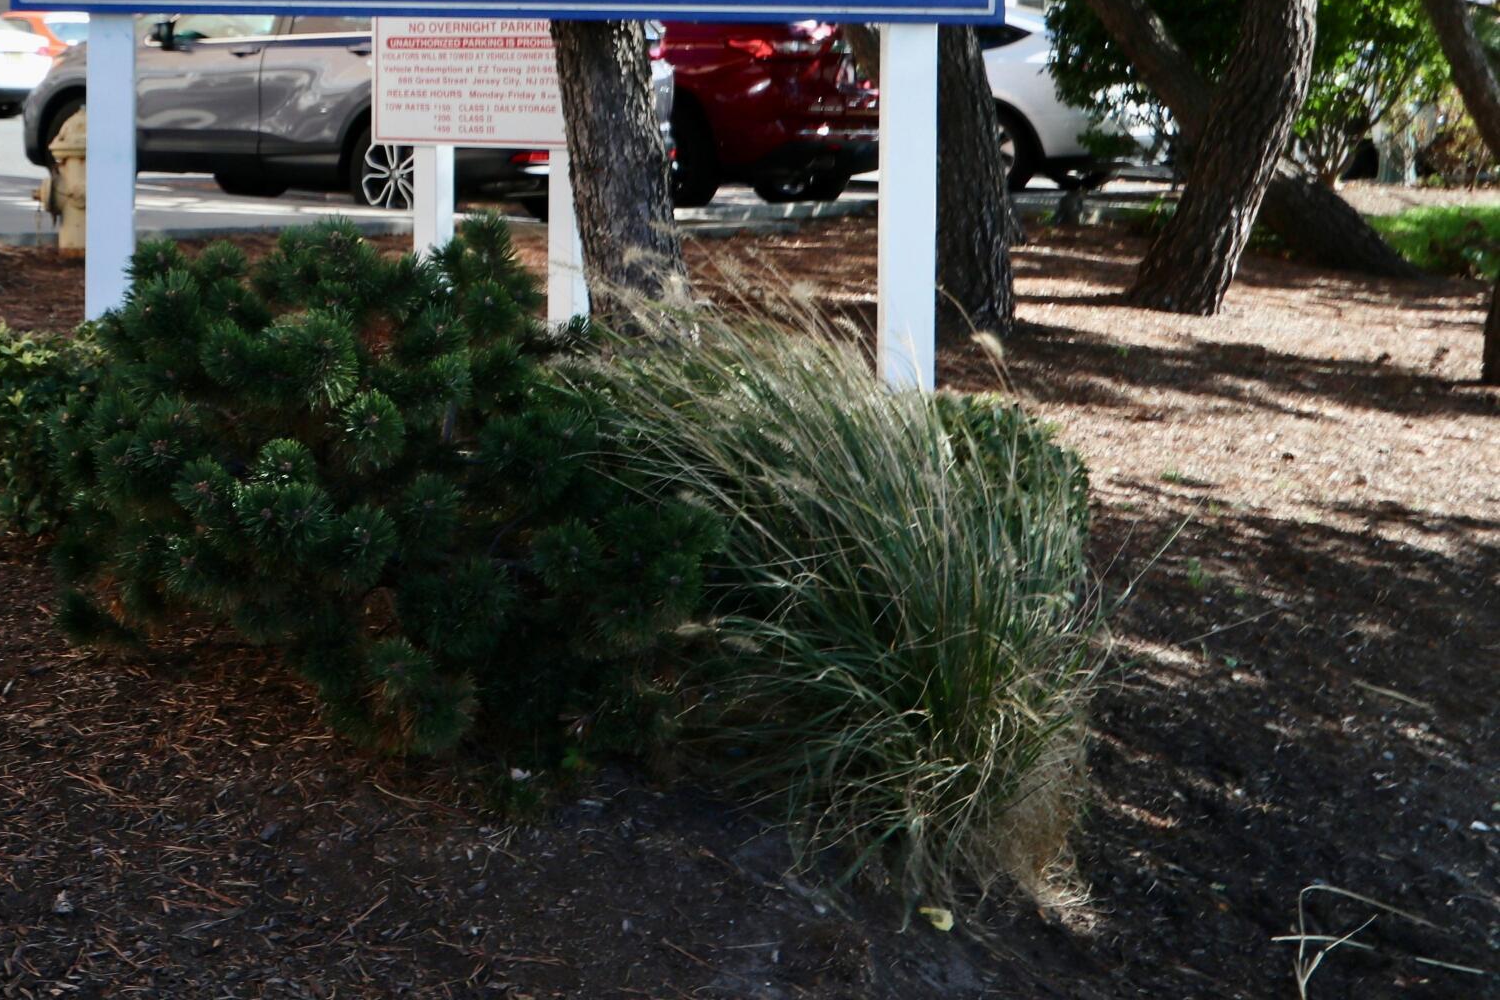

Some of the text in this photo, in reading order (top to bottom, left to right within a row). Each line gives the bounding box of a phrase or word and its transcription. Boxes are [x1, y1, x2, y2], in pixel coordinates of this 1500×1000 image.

[409, 23, 425, 33] NO
[429, 22, 496, 33] OVERNIGHT
[390, 38, 461, 48] UNAUTHORIZED
[463, 38, 503, 48] PARKING
[486, 52, 515, 61] VEHICLE
[492, 66, 521, 76] Towing
